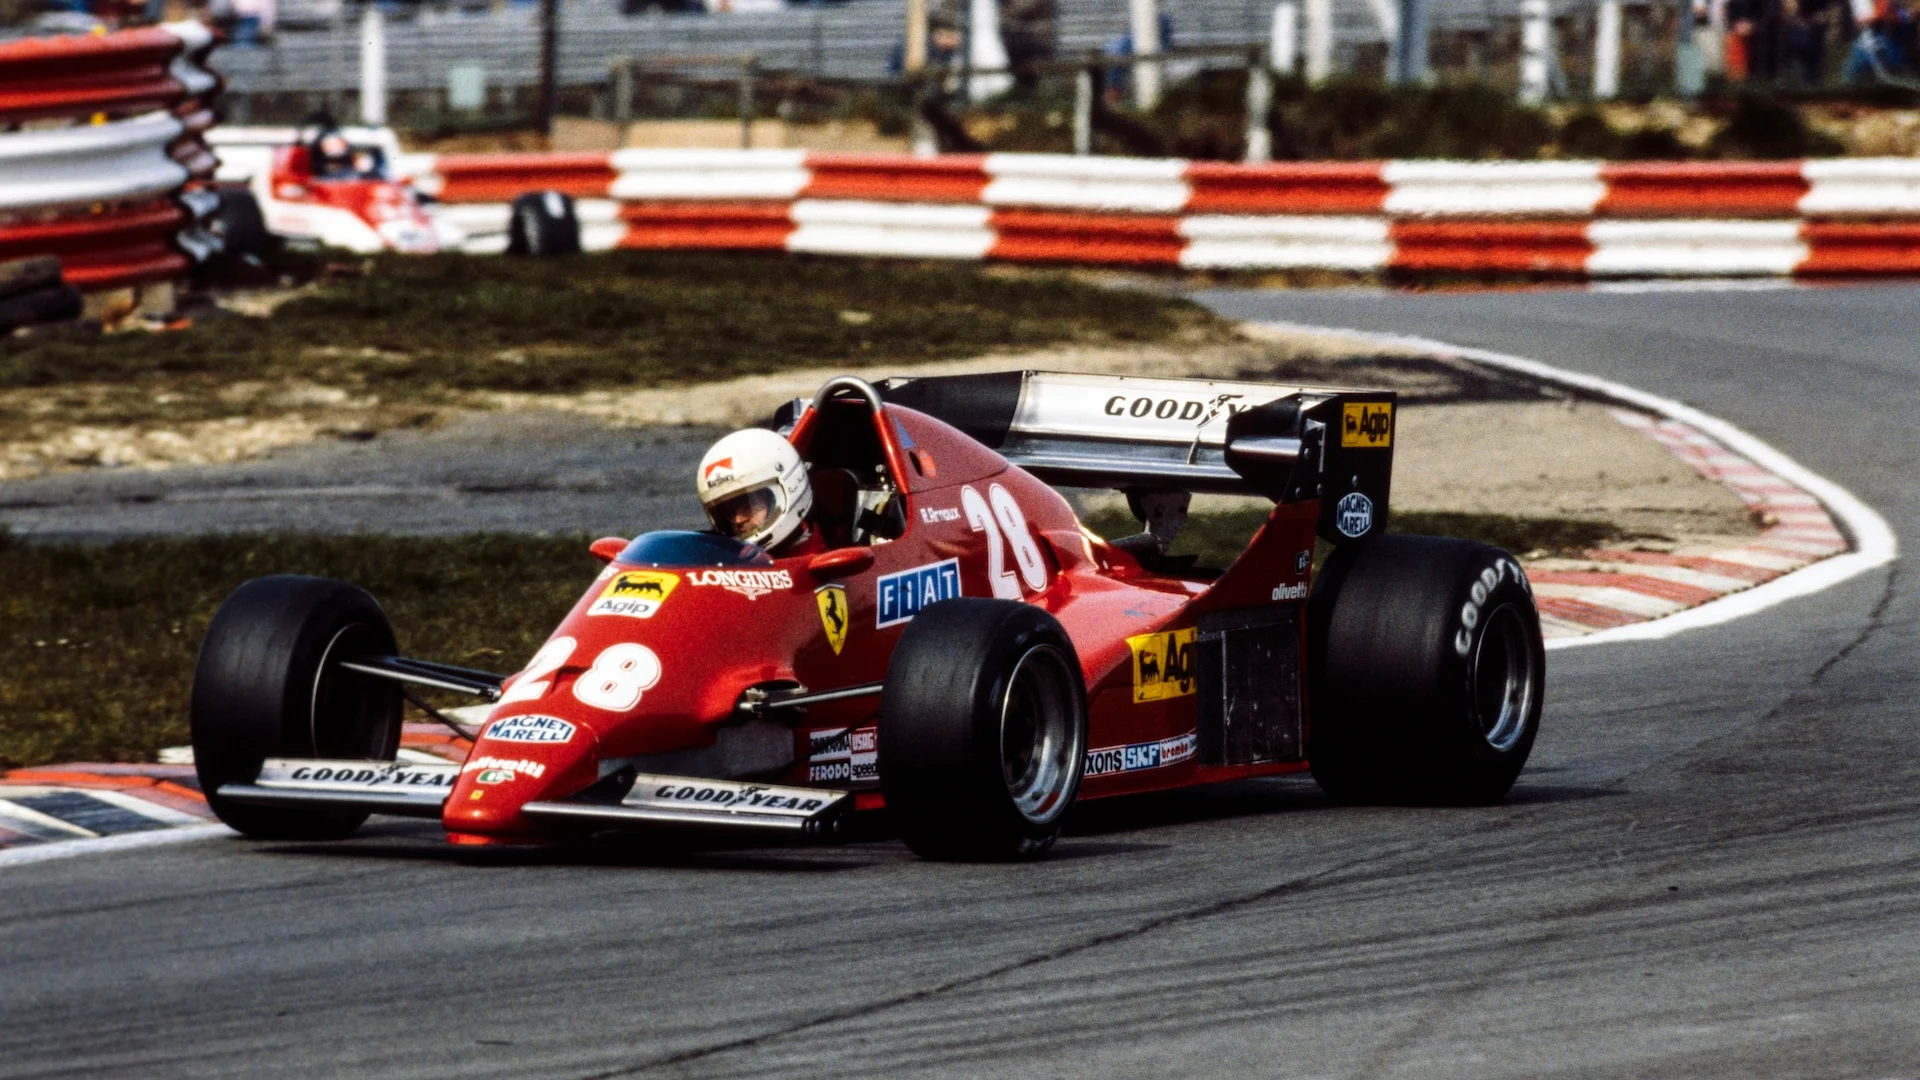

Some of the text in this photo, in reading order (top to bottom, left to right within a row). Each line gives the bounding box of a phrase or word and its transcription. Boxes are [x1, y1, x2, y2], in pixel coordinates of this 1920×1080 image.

[1104, 396, 1250, 423] GOODY
[1359, 405, 1389, 442] Agip
[1338, 495, 1372, 514] MAGNETI
[1338, 516, 1371, 535] MARELLI
[960, 482, 1048, 602] 28
[686, 570, 793, 590] LONGINES
[1272, 581, 1307, 601] olivetti
[883, 569, 956, 617] FIAT
[595, 599, 651, 614] Agip
[497, 635, 662, 712] 28
[1162, 632, 1197, 694] Agi
[487, 716, 573, 734] MAGNETI
[487, 726, 572, 741] MARELLI
[462, 756, 546, 778] olivetti
[1083, 750, 1122, 774] xons
[1126, 743, 1160, 769] SKF
[809, 763, 850, 781] FERODO
[655, 785, 823, 812] GOODYEAR
